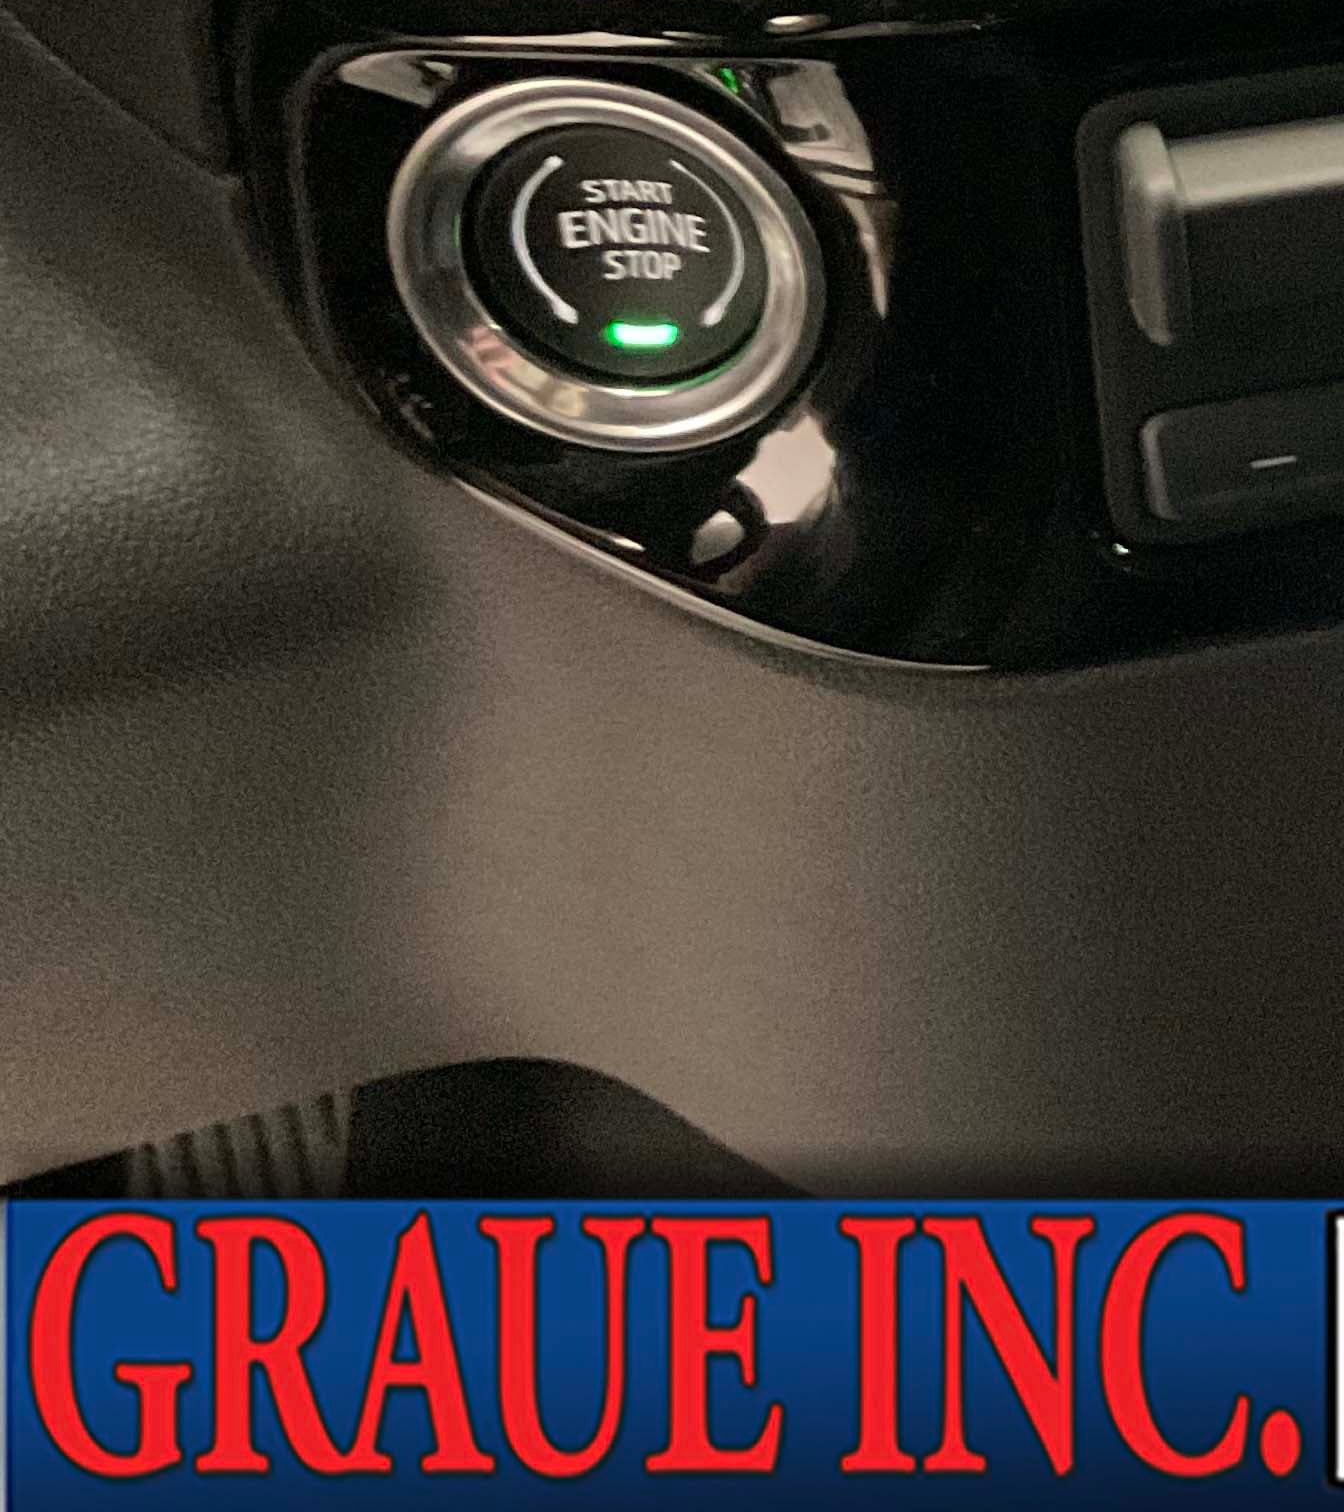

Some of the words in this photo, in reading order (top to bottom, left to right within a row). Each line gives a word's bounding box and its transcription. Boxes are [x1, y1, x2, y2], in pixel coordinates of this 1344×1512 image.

[581, 178, 673, 205] START
[557, 208, 711, 253] ENGINE
[603, 249, 683, 281] STOP
